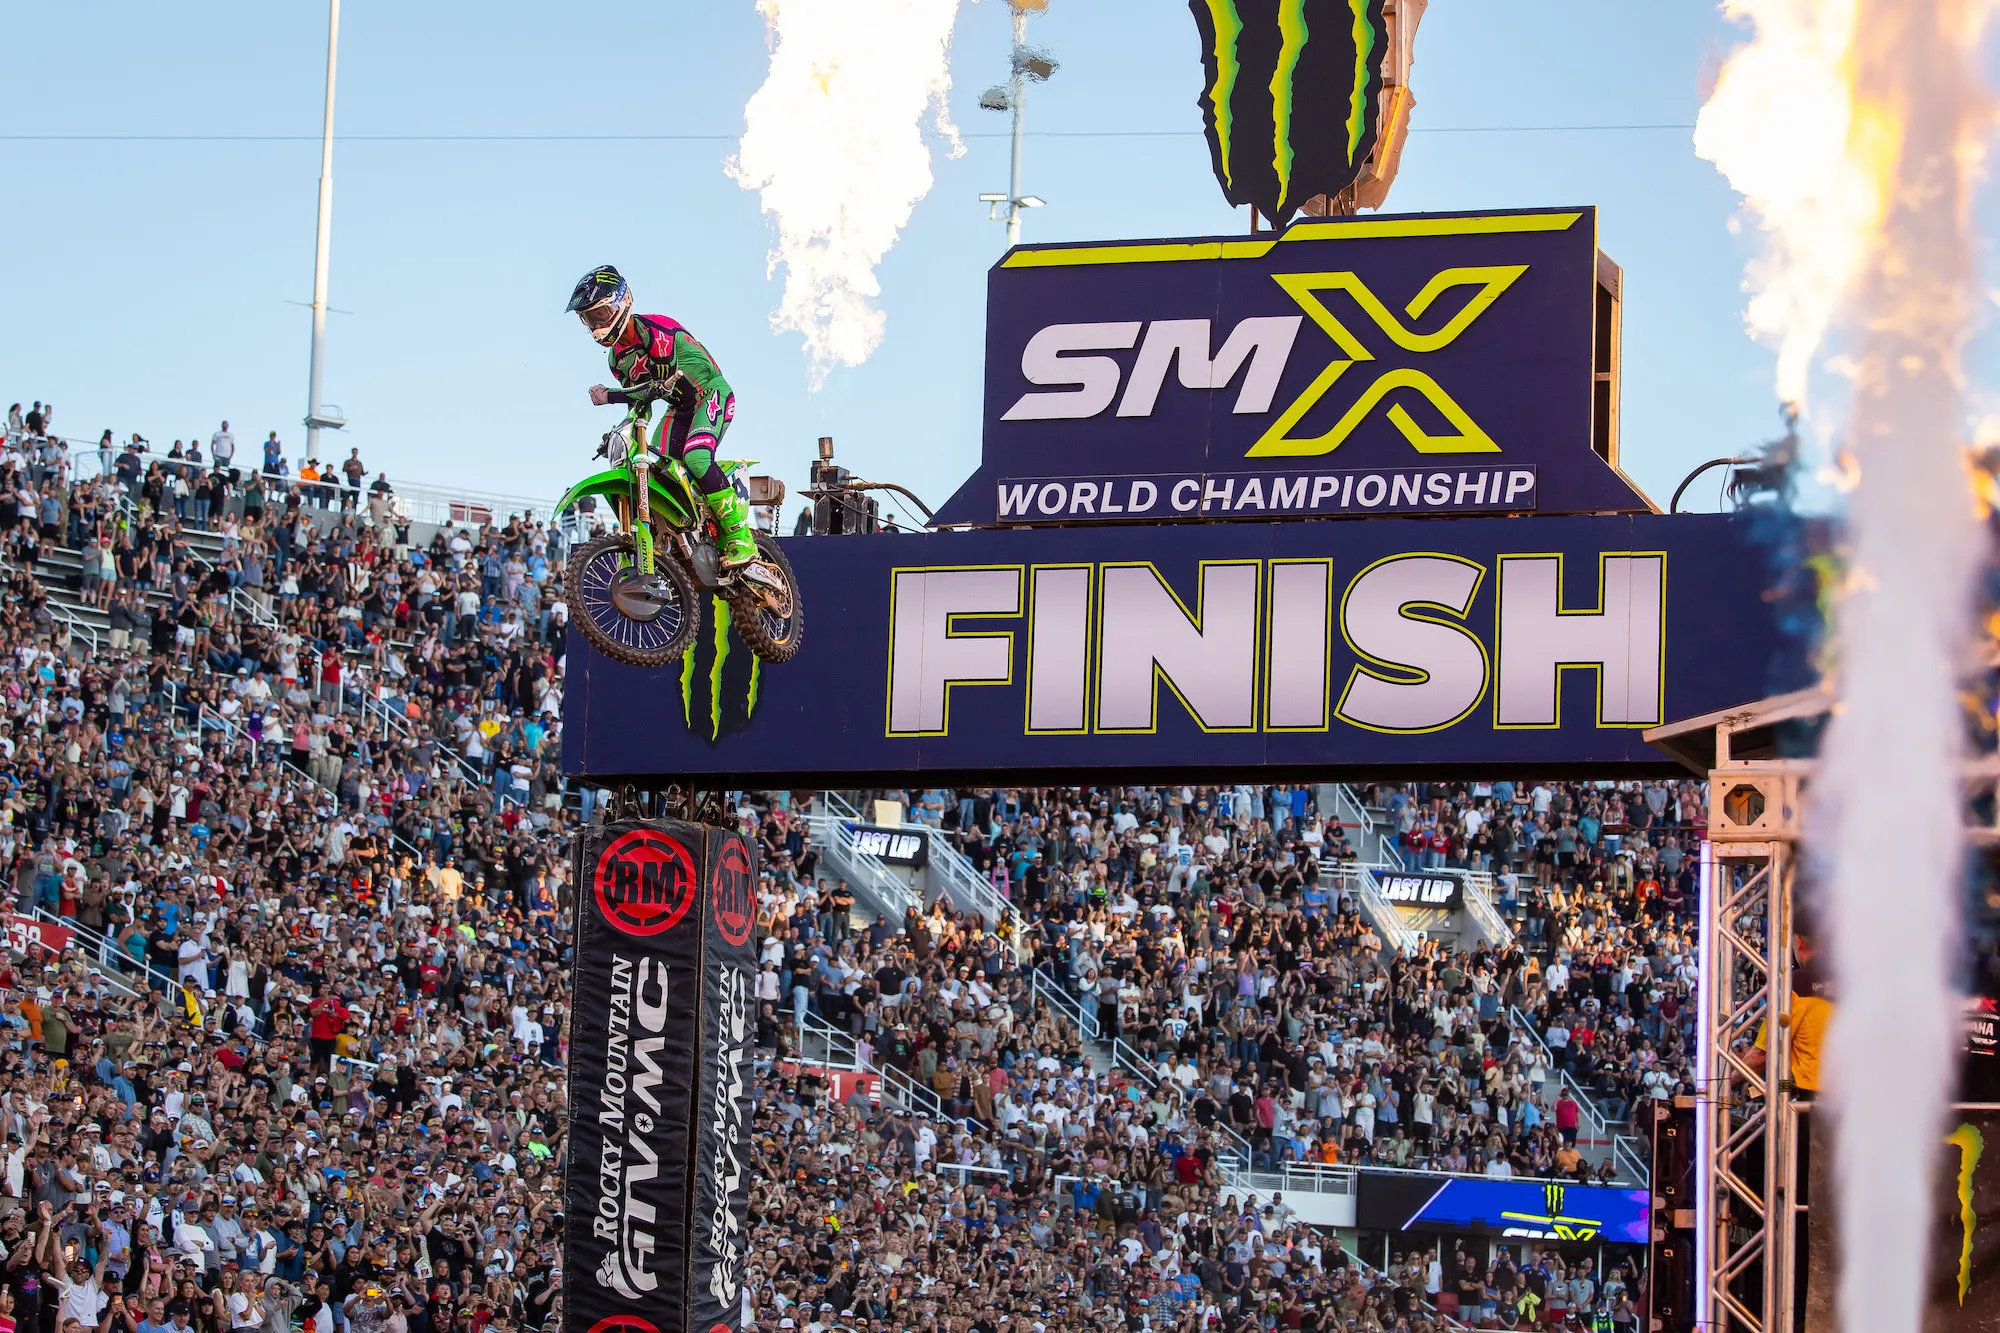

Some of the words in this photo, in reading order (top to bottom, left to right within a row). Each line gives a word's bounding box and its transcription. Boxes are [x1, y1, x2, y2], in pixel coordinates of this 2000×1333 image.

[1000, 264, 1530, 458] SMX
[998, 482, 1158, 516] WORLD
[1168, 470, 1536, 512] CHAMPIONSHIP
[885, 551, 1668, 738] FINISH
[614, 861, 676, 905] RM
[719, 869, 750, 917] RM
[852, 830, 891, 857] LAST
[888, 834, 921, 860] LAP
[1380, 876, 1422, 901] LAST
[1420, 878, 1455, 903] LAP
[598, 953, 634, 1131] MOUNTAIN
[713, 961, 731, 1146] MOUNTAIN
[593, 1136, 623, 1246] ROCKY
[708, 1145, 727, 1258] ROCKY
